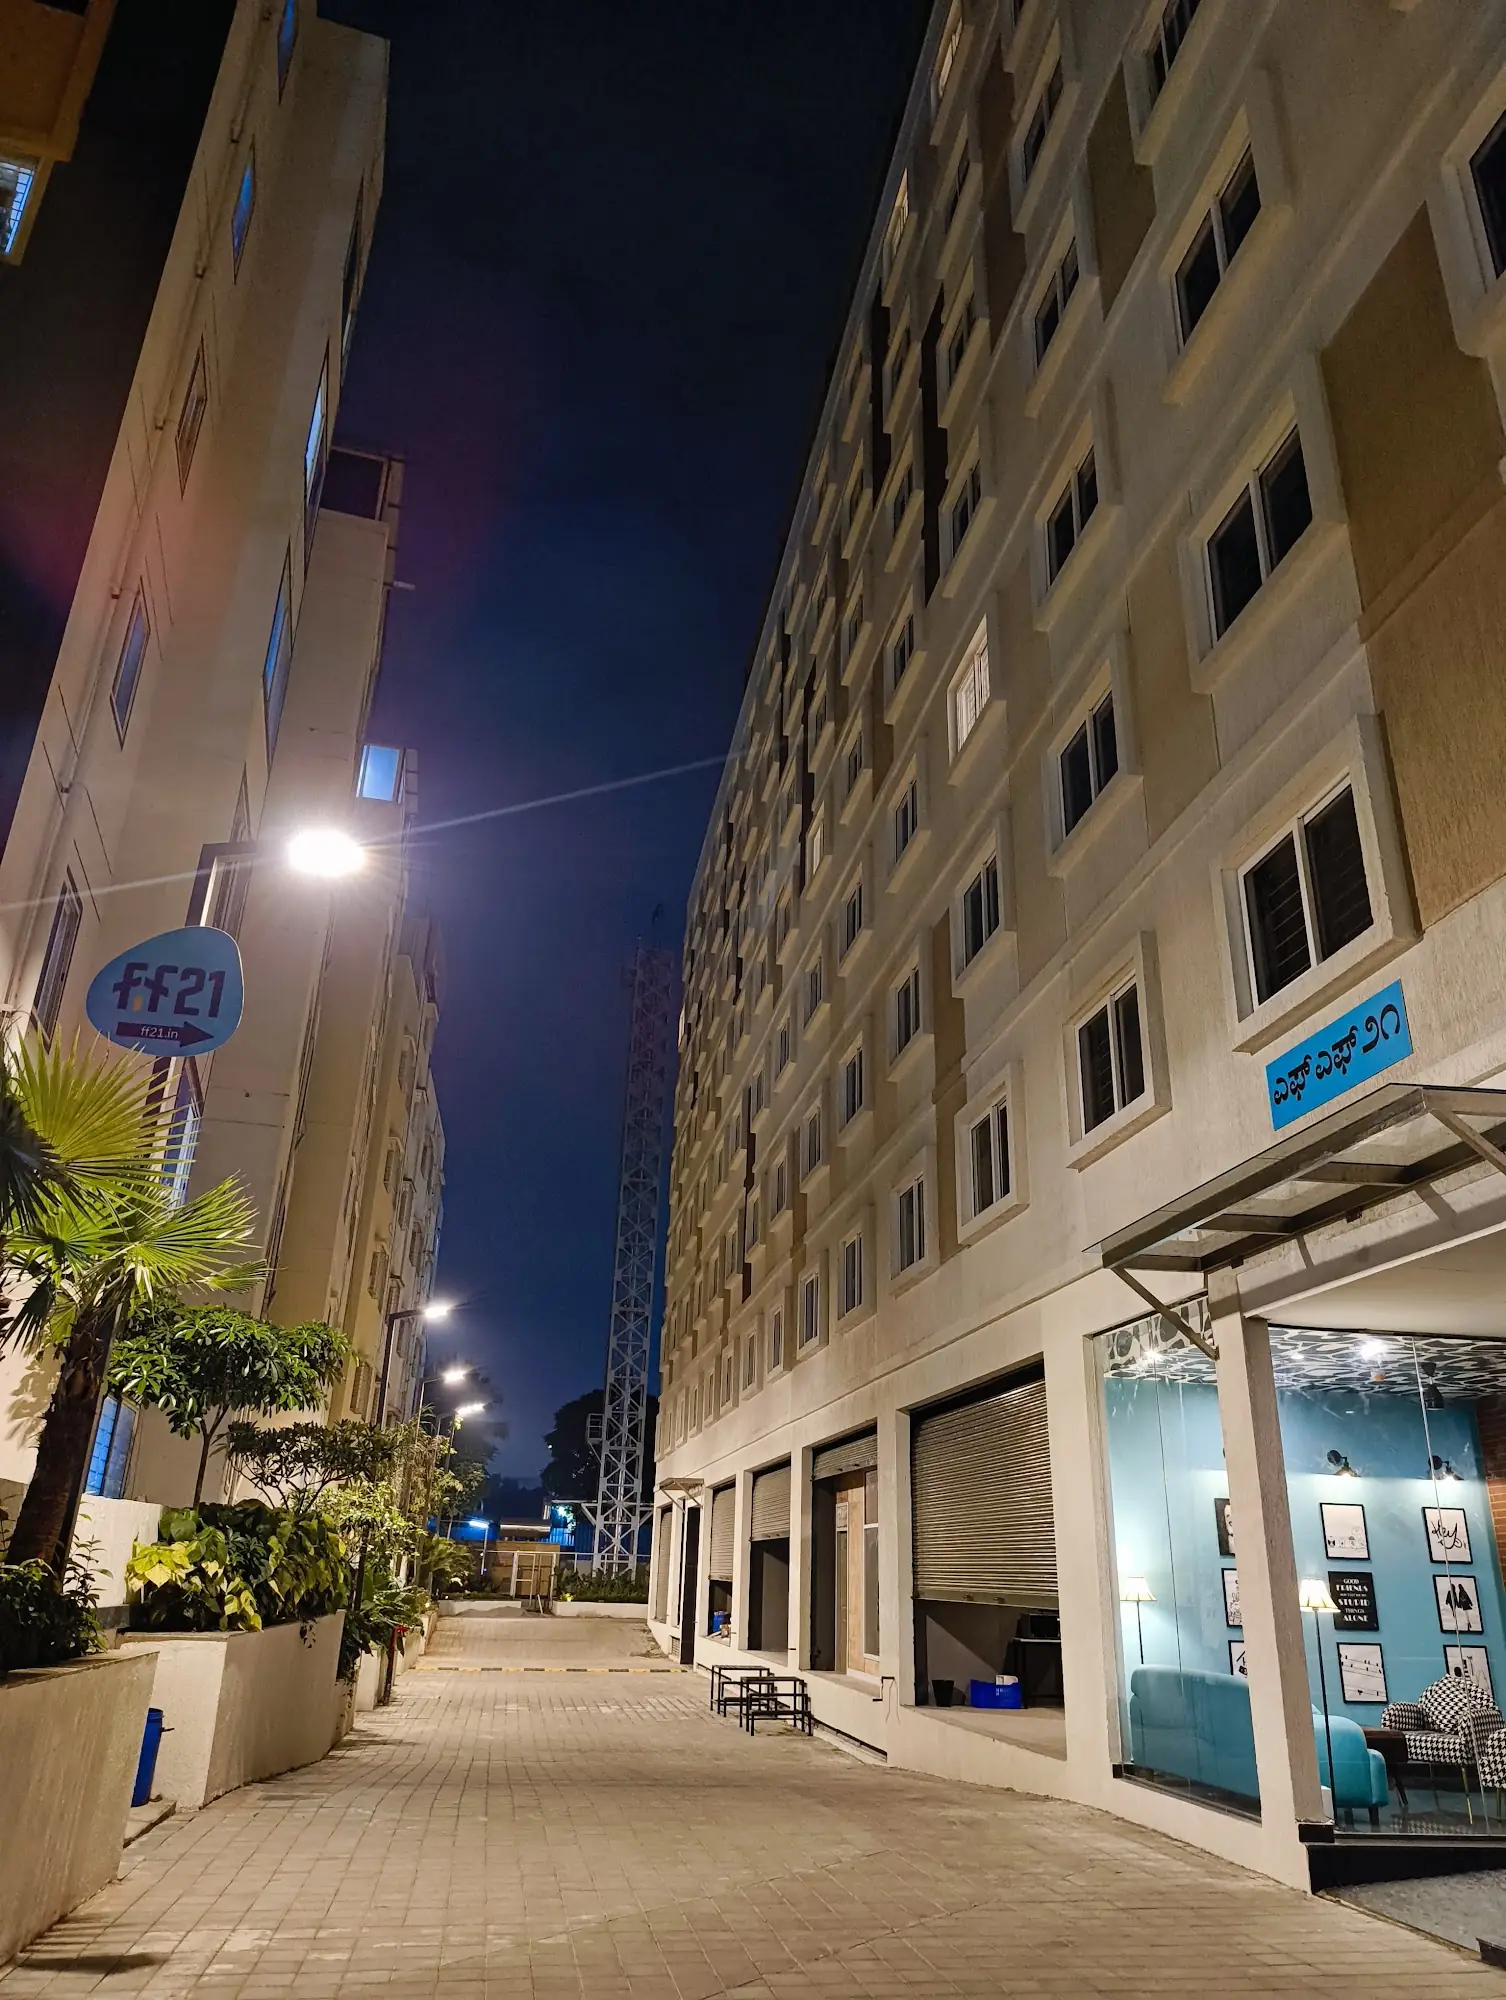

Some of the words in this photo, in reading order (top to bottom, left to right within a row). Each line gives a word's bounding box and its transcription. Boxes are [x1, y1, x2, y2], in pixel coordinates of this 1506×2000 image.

[140, 1027, 179, 1039] ff21.in
[1338, 1598, 1370, 1606] STUPID
[1343, 1614, 1368, 1622] ALONE
